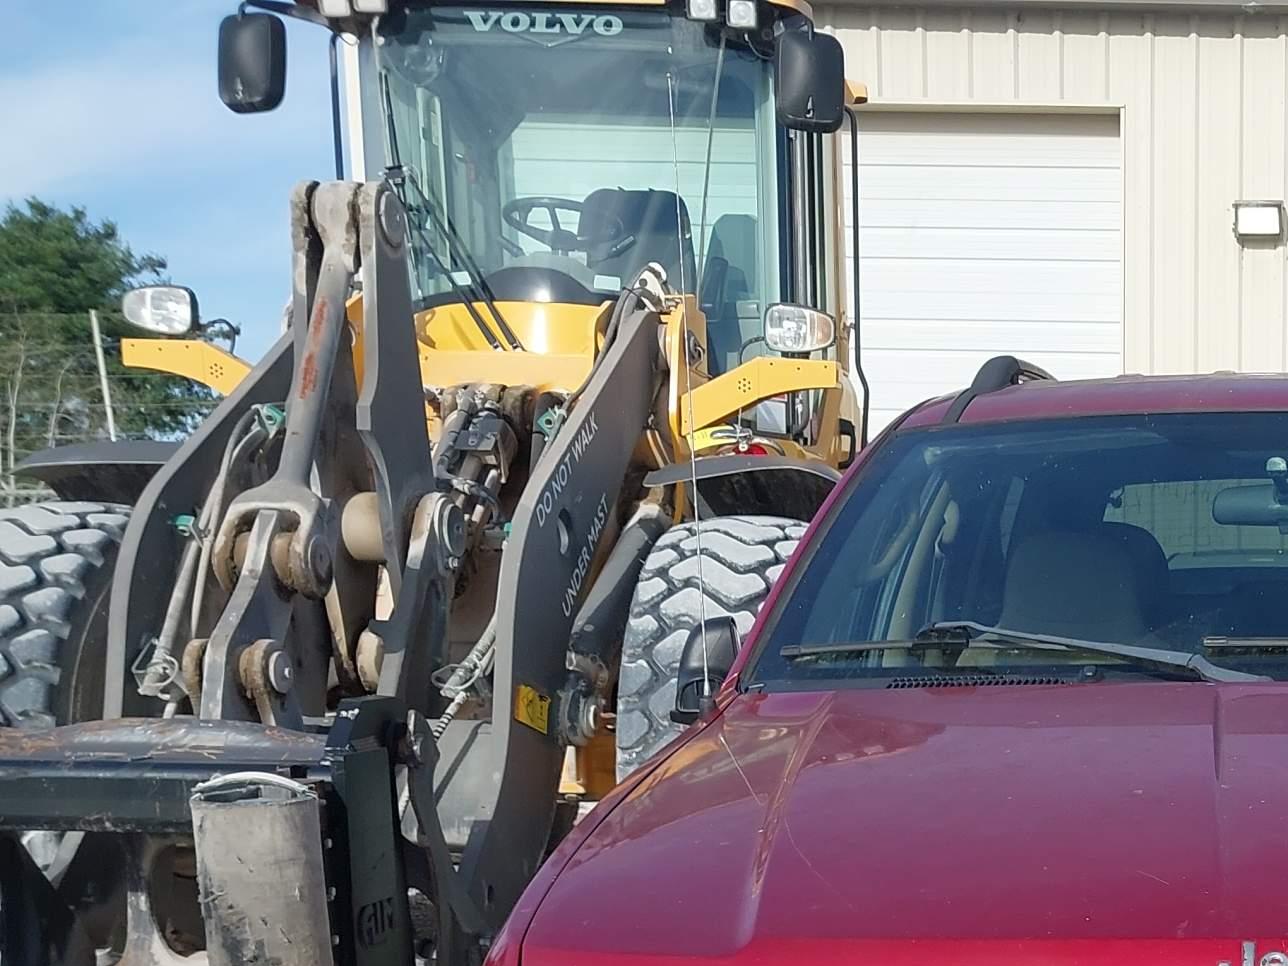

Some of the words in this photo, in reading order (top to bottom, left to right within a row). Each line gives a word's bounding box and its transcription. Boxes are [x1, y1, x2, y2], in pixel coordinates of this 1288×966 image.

[463, 10, 624, 36] VOLVO
[536, 491, 554, 528] DO
[551, 453, 573, 500] NOT
[571, 411, 600, 463] WALK
[561, 545, 591, 618] UNDER
[587, 493, 610, 552] MAST
